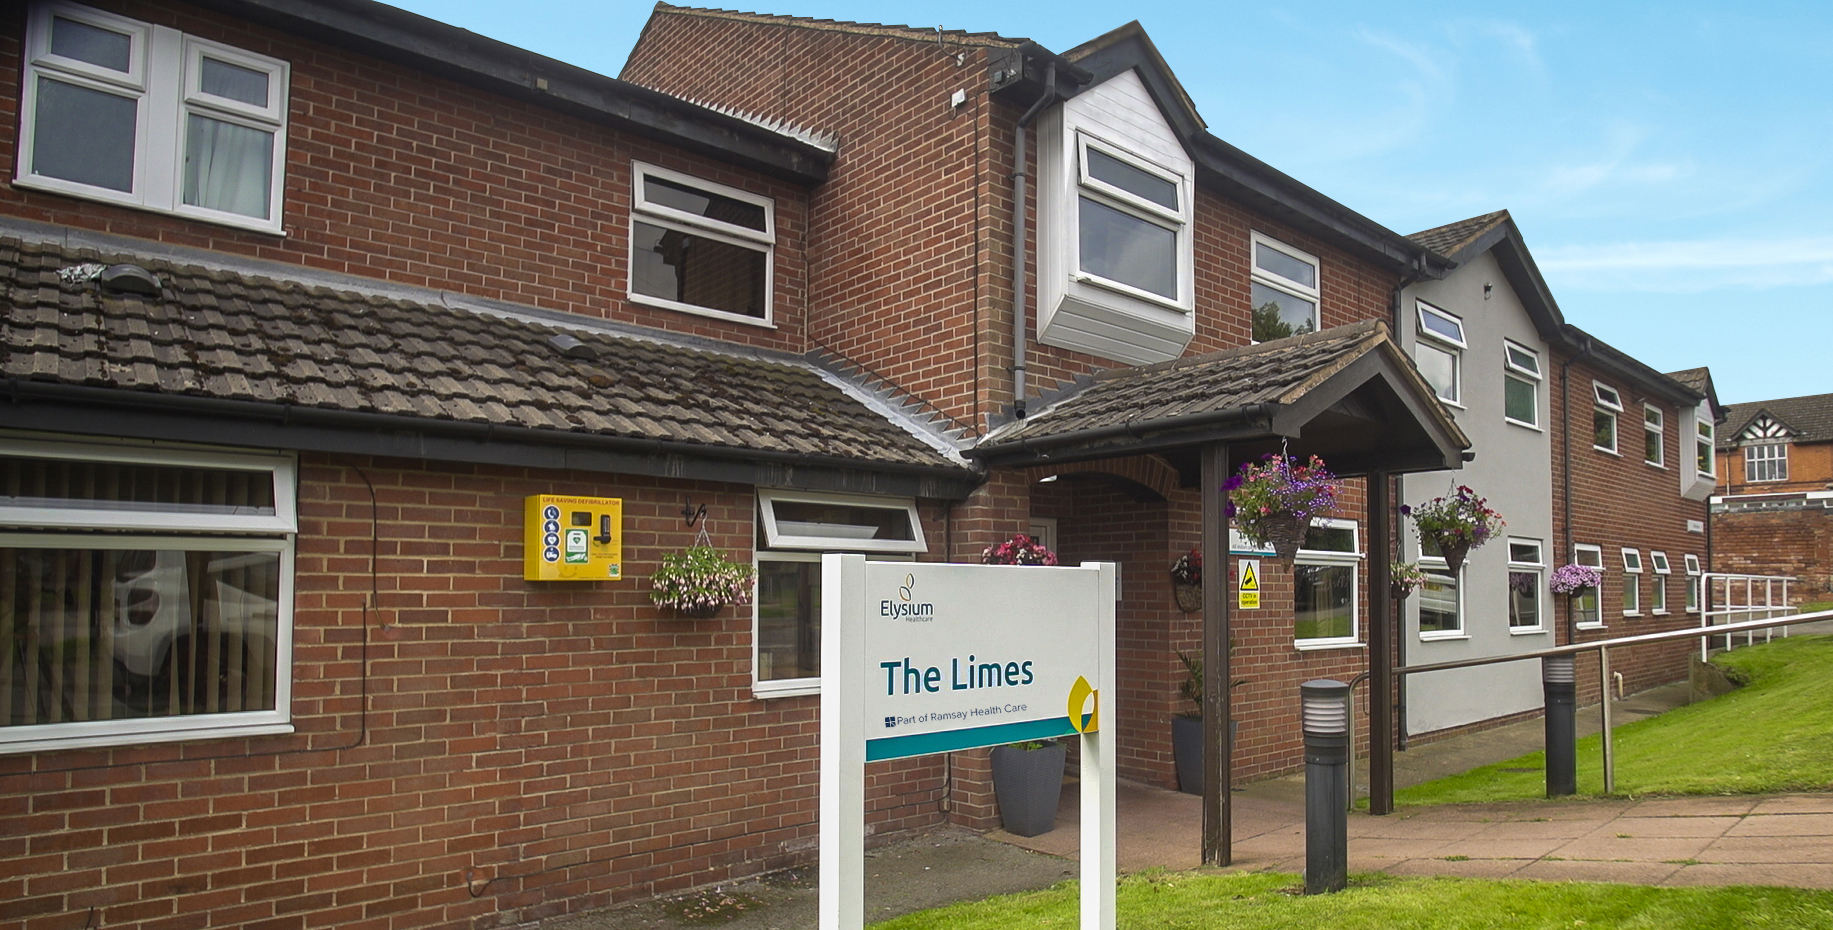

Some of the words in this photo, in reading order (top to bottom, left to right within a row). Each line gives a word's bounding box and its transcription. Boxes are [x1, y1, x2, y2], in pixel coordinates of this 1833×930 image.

[880, 600, 933, 620] Elysium
[880, 657, 941, 695] The
[952, 655, 1033, 690] Limes
[896, 715, 916, 726] Part
[918, 713, 928, 723] of
[931, 710, 968, 722] Ramsay
[970, 706, 1002, 717] Health
[1004, 703, 1028, 713] Care
